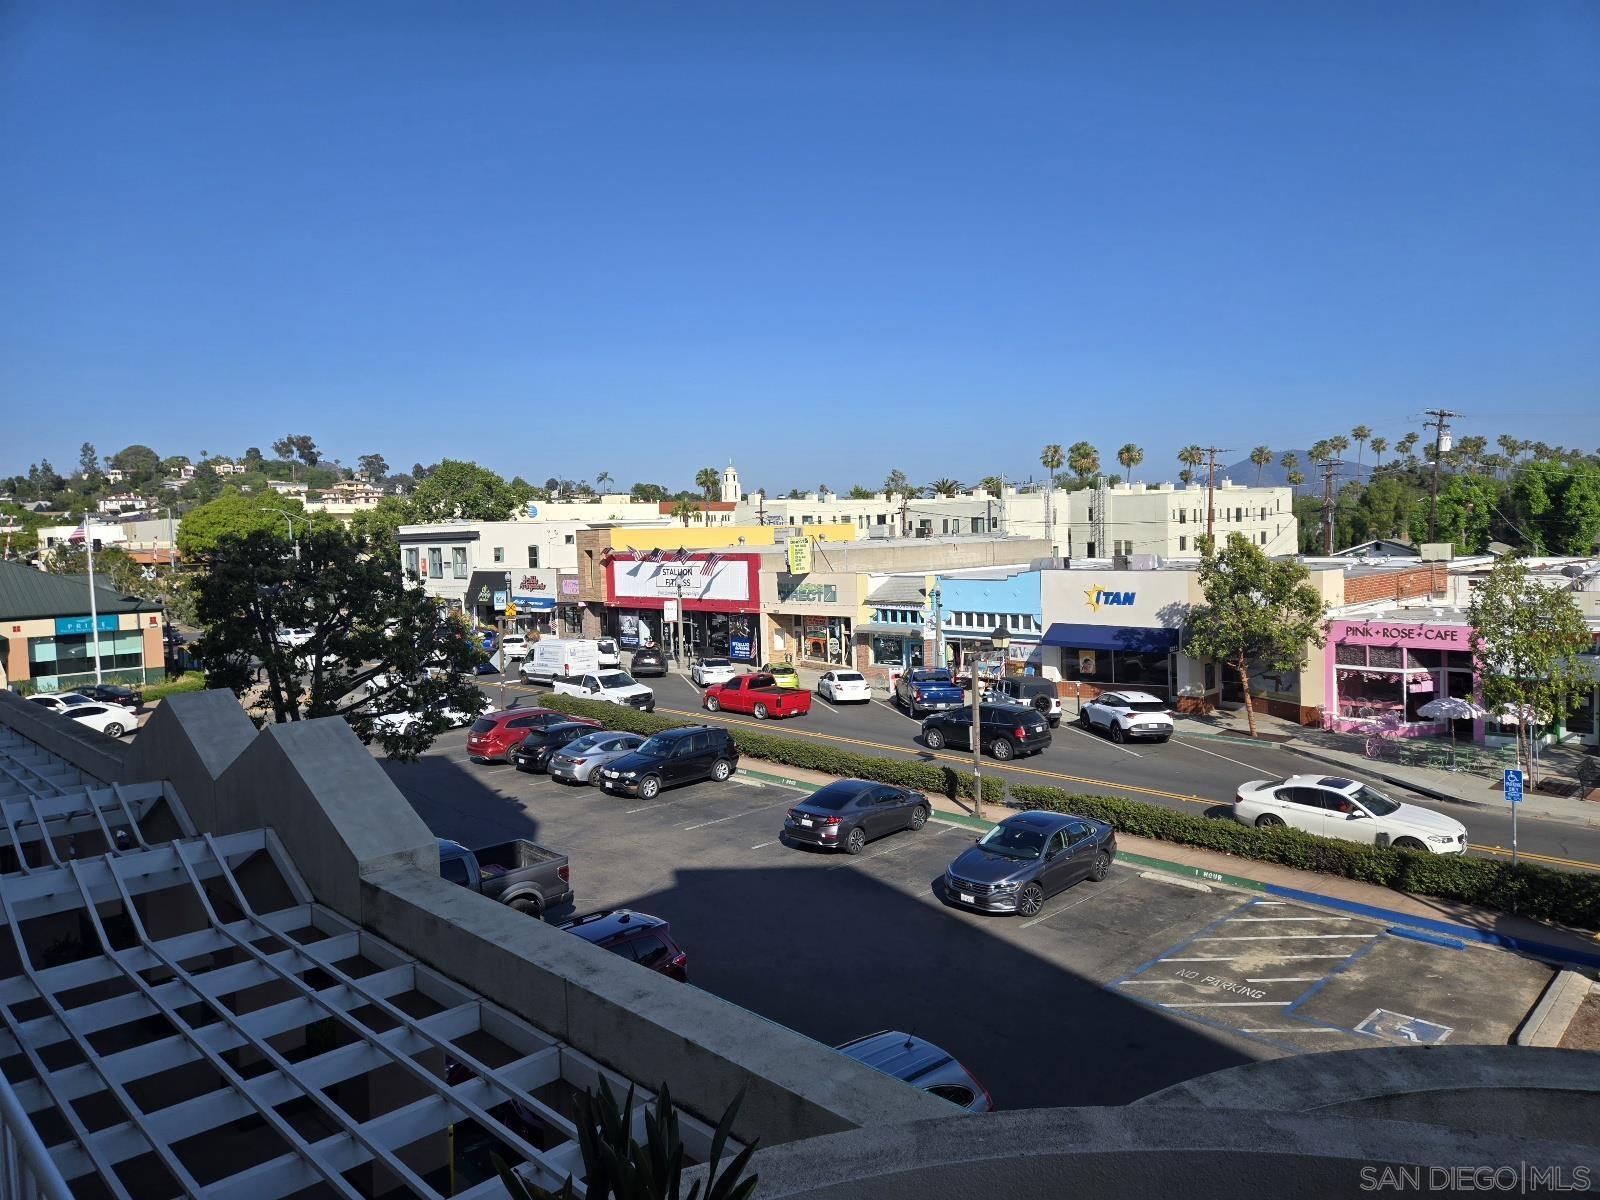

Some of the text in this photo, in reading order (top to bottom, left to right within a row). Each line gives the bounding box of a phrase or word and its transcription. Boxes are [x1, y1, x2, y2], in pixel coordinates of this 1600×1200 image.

[665, 578, 691, 587] FITSS
[1345, 625, 1458, 642] PINK ROSE CAFE
[1203, 871, 1223, 881] HOUR
[1175, 968, 1267, 999] NO PARKING
